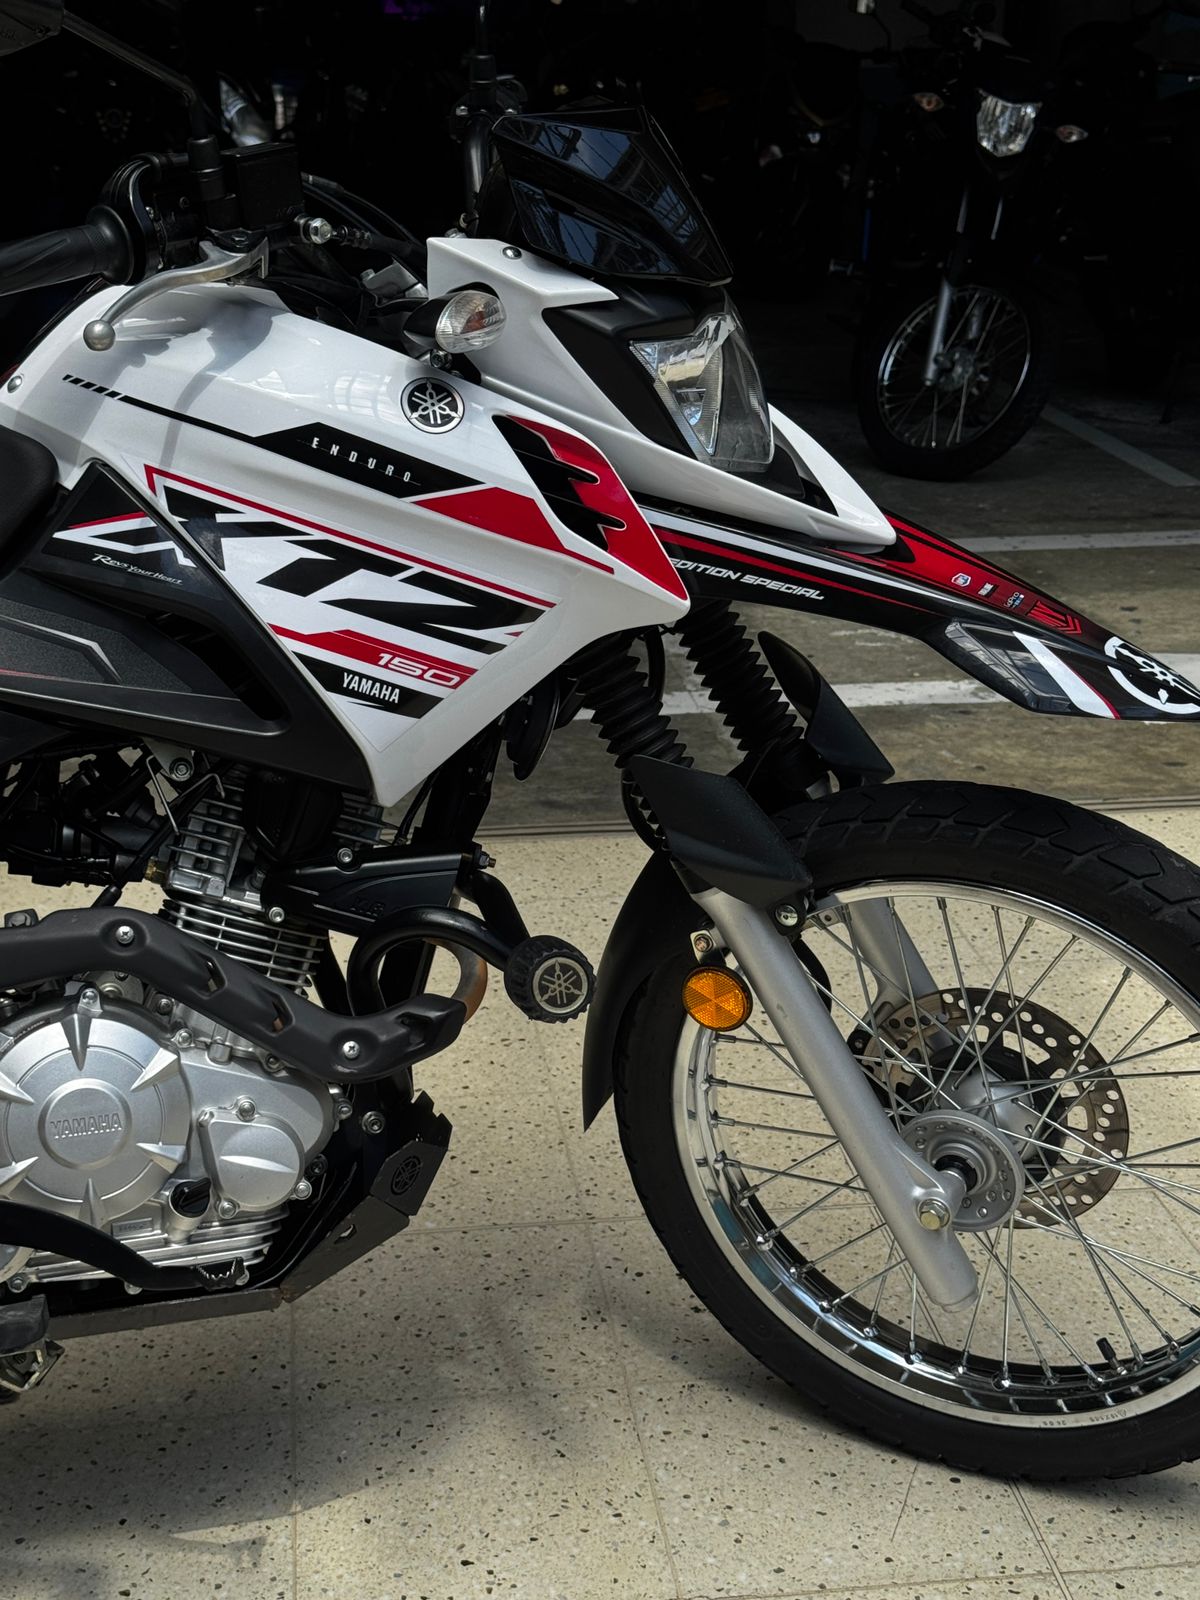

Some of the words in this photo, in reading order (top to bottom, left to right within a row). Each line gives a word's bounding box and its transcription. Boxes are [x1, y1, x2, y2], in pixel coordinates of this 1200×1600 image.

[311, 437, 411, 482] ENDURO
[80, 485, 547, 655] XTZ
[92, 553, 128, 568] Revs
[127, 565, 155, 578] Your
[153, 573, 184, 586] Heart
[740, 574, 824, 600] SPECIAL
[377, 652, 461, 686] 150
[342, 672, 400, 704] YAMAHA
[49, 1112, 122, 1139] YAMAHA
